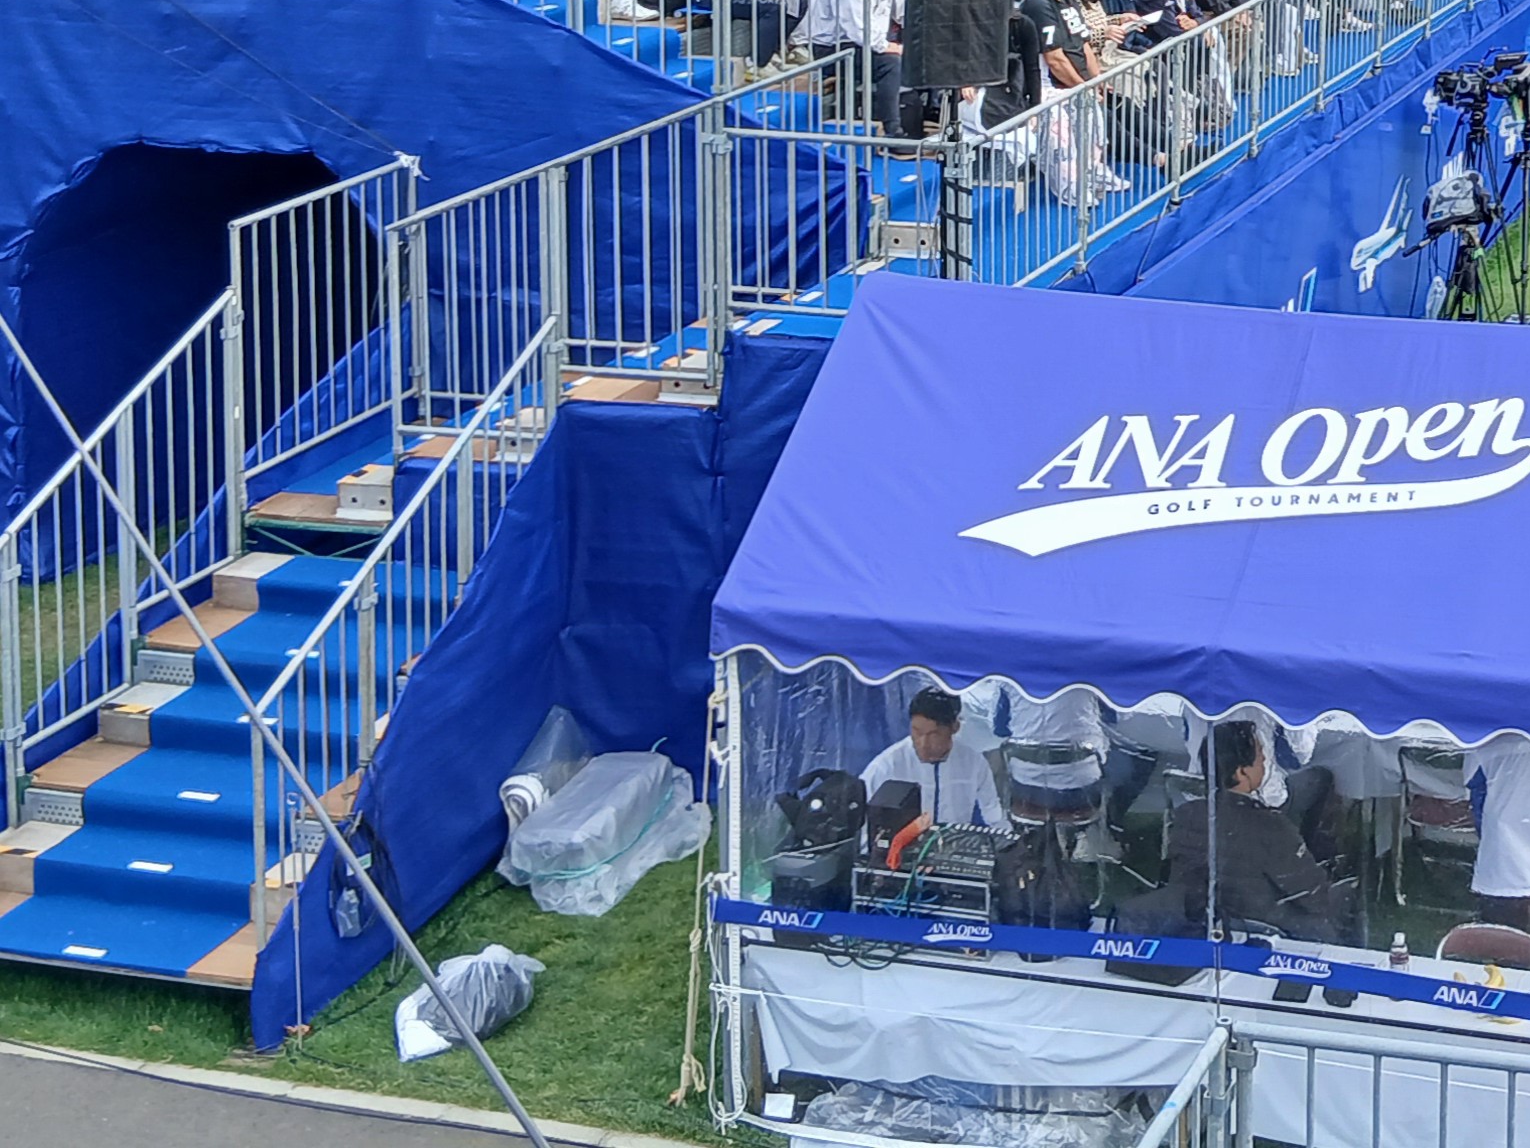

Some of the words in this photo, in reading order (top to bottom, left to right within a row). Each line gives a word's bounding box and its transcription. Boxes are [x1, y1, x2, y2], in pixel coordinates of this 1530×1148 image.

[1042, 25, 1056, 45] 7
[1017, 413, 1236, 490] ANA
[1260, 397, 1527, 487] Open
[1147, 498, 1213, 516] GOLF
[1235, 489, 1417, 508] TOURNAMENT
[758, 909, 800, 927] ANA
[927, 922, 954, 935] ANA
[956, 924, 990, 937] Open
[1090, 939, 1134, 958] ANA
[1264, 955, 1291, 969] ANA
[1294, 956, 1330, 973] Open
[1433, 985, 1478, 1007] ANA
